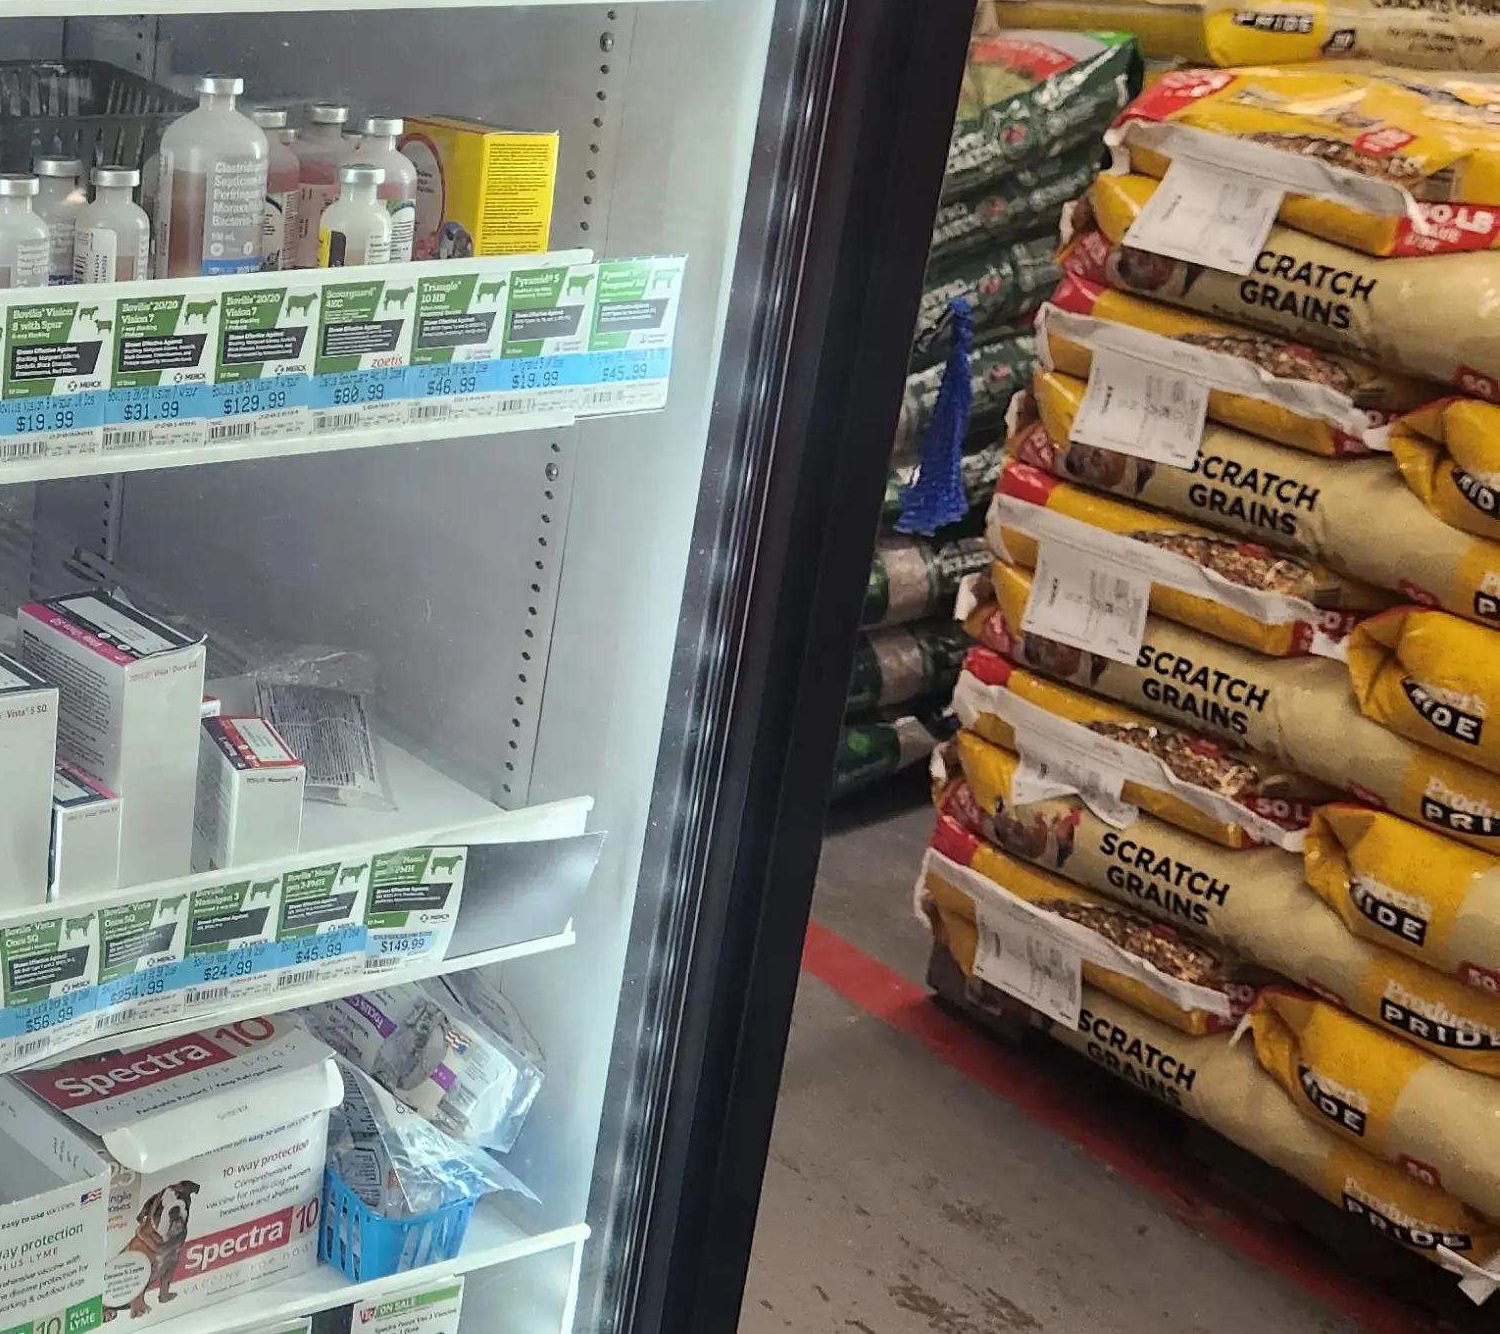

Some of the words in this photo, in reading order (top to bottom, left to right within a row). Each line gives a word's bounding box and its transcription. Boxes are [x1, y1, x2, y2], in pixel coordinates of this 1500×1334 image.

[1254, 250, 1377, 302] CRATCH
[46, 307, 73, 317] Vision
[122, 315, 148, 324] Vision
[226, 308, 249, 317] Vision
[1239, 280, 1351, 331] GRAINS
[372, 356, 403, 368] zoetis
[512, 371, 558, 389] $19.99
[124, 401, 179, 421] $31.99
[224, 391, 286, 415] $129.99
[16, 411, 74, 432] $19.99
[1186, 449, 1320, 512] SCRATCH
[1188, 487, 1298, 536] GRAINS
[1137, 645, 1270, 713] SCRATCH
[1142, 678, 1248, 736] GRAINS
[1100, 833, 1231, 907] SCRATCH
[1106, 866, 1209, 926] GRAINS
[296, 943, 342, 965] $45.99
[380, 938, 424, 953] $149.99
[204, 960, 252, 981] $24.99
[55, 1041, 212, 1099] Spectra
[214, 1017, 275, 1048] 10
[1078, 1009, 1197, 1093] SCRATCH
[1086, 1042, 1182, 1108] GRAINS
[222, 1159, 260, 1178] 10-way
[261, 1139, 310, 1167] protection
[21, 1223, 84, 1252] protection
[184, 1220, 283, 1272] Spectra
[70, 1314, 95, 1331] LYME
